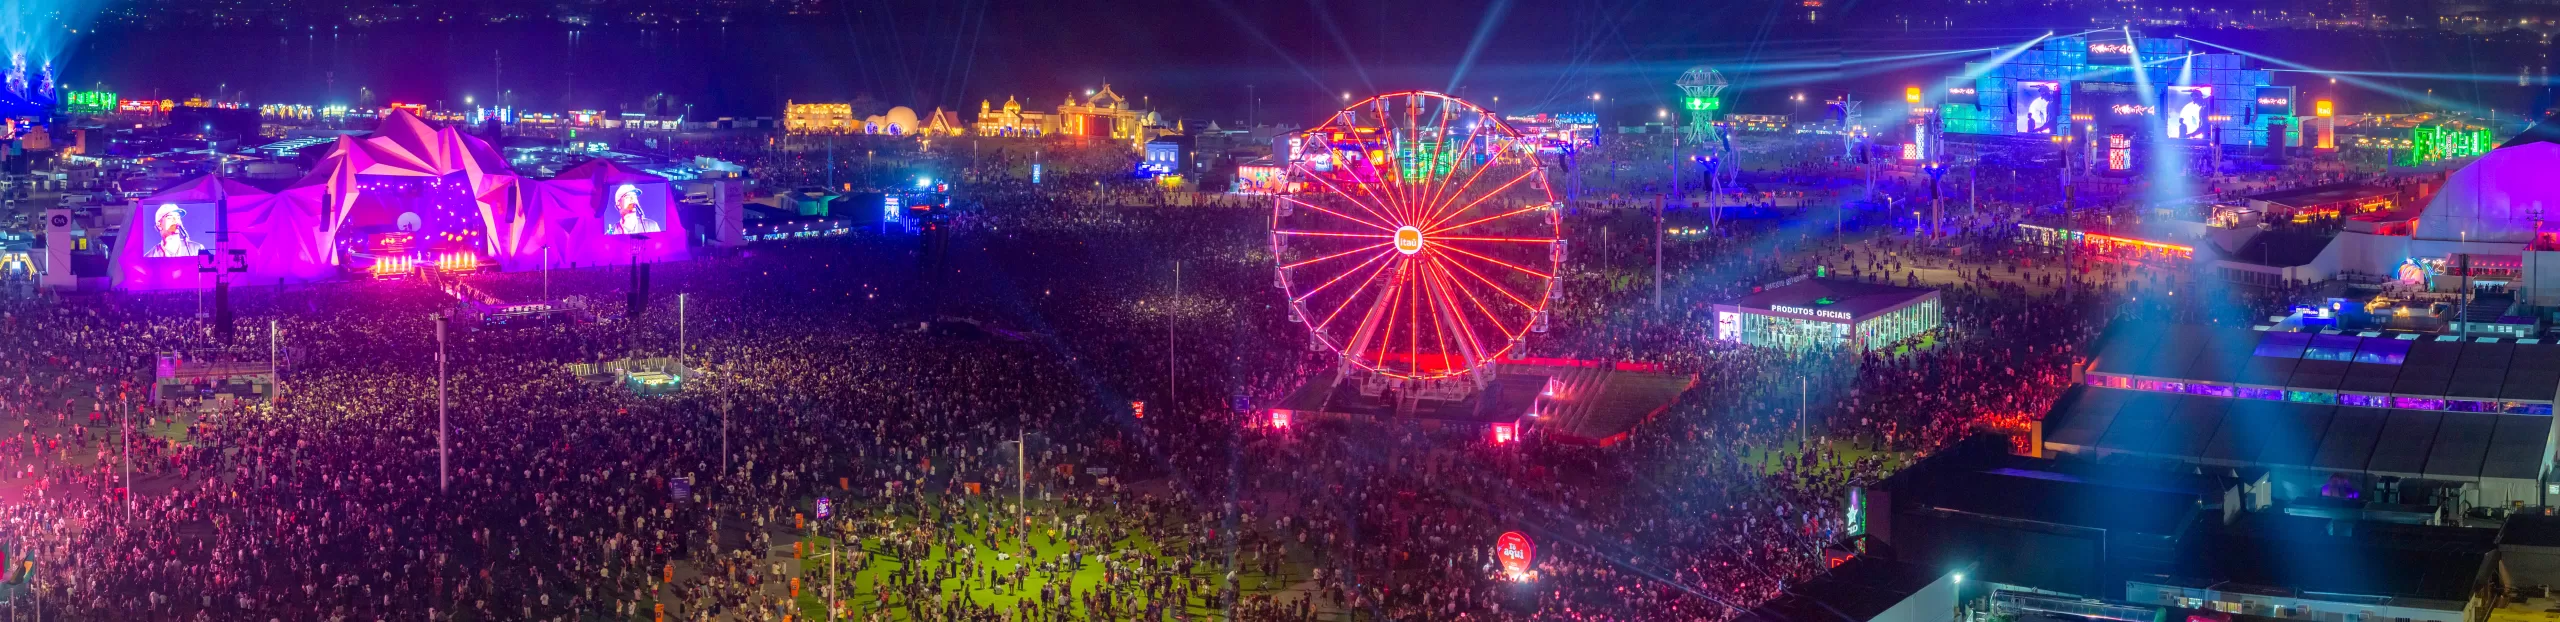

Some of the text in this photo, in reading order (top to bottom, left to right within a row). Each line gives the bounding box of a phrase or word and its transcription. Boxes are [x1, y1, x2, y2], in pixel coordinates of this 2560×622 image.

[1400, 237, 1417, 247] itaú
[1771, 304, 1852, 320] PRODUTOS OFICIAIS
[1503, 547, 1525, 560] aqui
